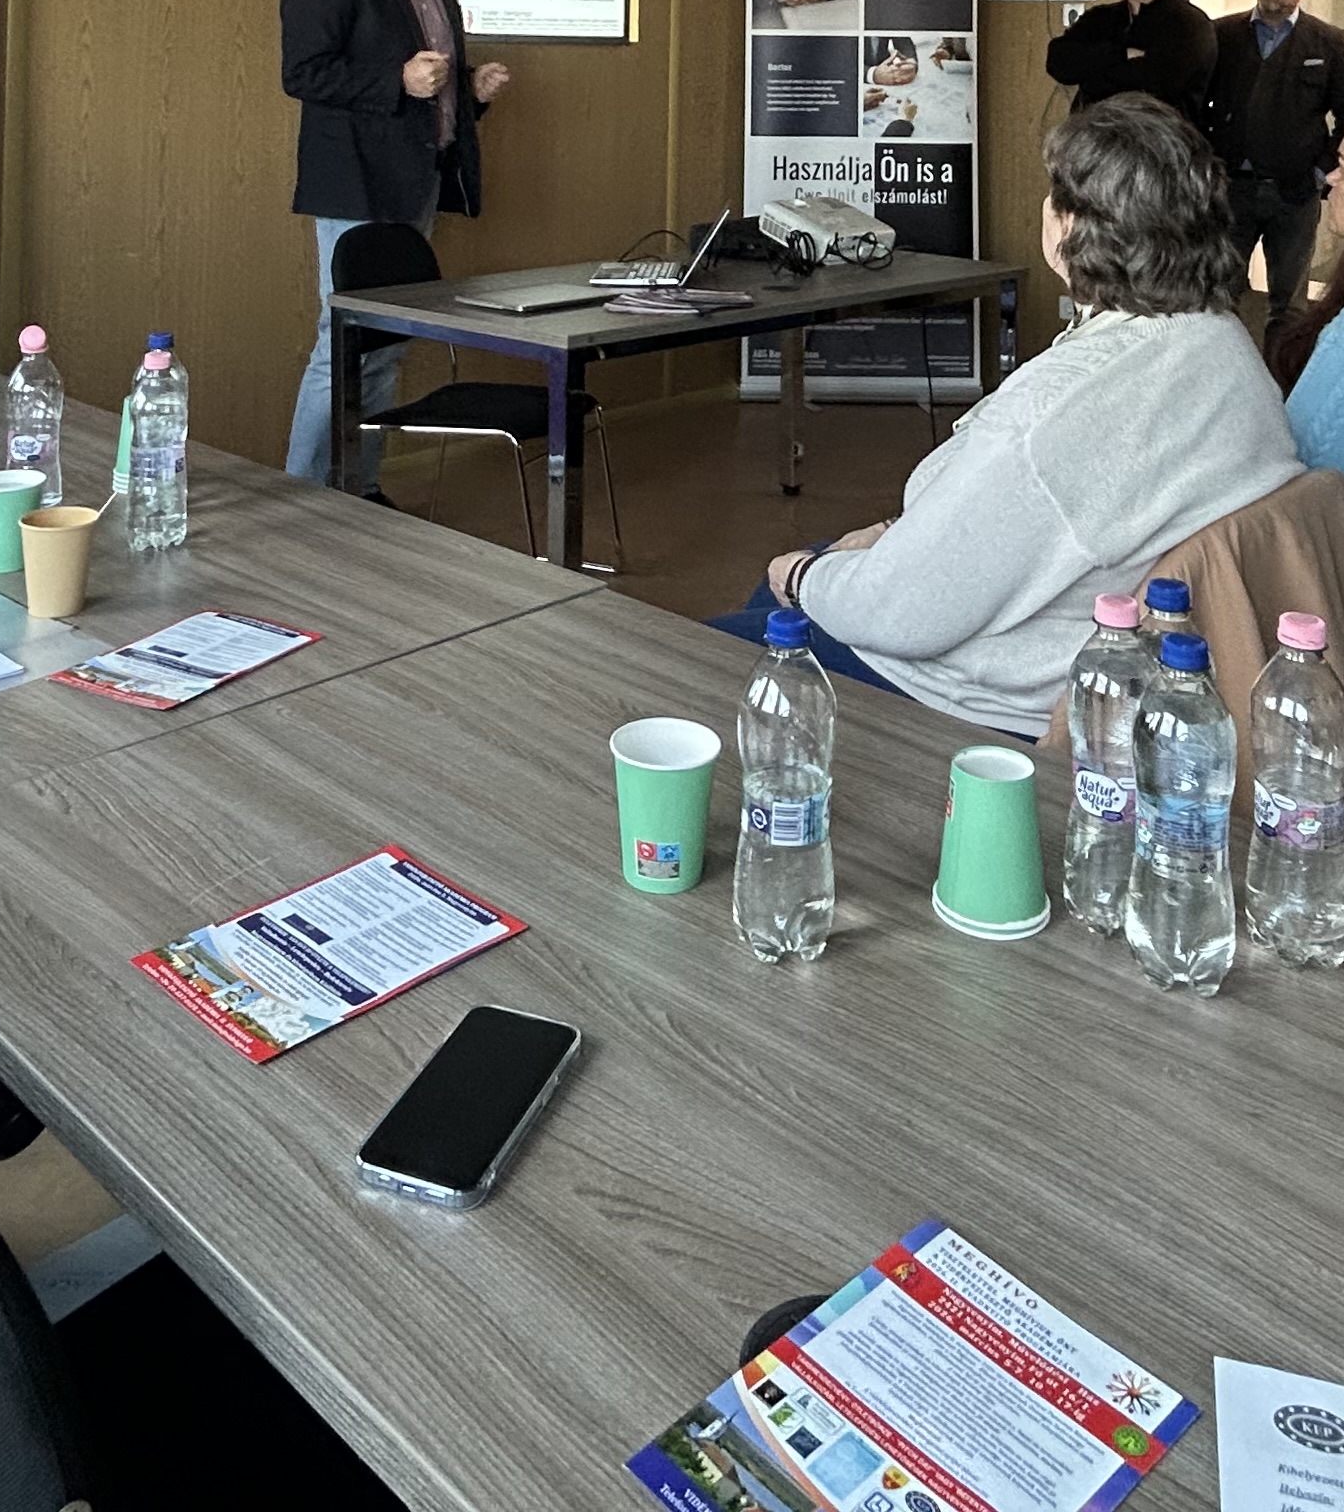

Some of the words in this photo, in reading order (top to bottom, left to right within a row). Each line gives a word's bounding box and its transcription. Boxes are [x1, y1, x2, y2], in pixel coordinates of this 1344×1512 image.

[773, 155, 873, 185] Használja
[880, 149, 909, 183] Ön
[916, 157, 934, 183] is
[941, 163, 953, 183] a
[861, 188, 948, 205] elszámolást!
[1080, 774, 1116, 797] Natur
[1081, 789, 1113, 808] aqua
[946, 1237, 1038, 1309] MEGHÍVÓ
[1278, 1463, 1344, 1489] Kihelyezett
